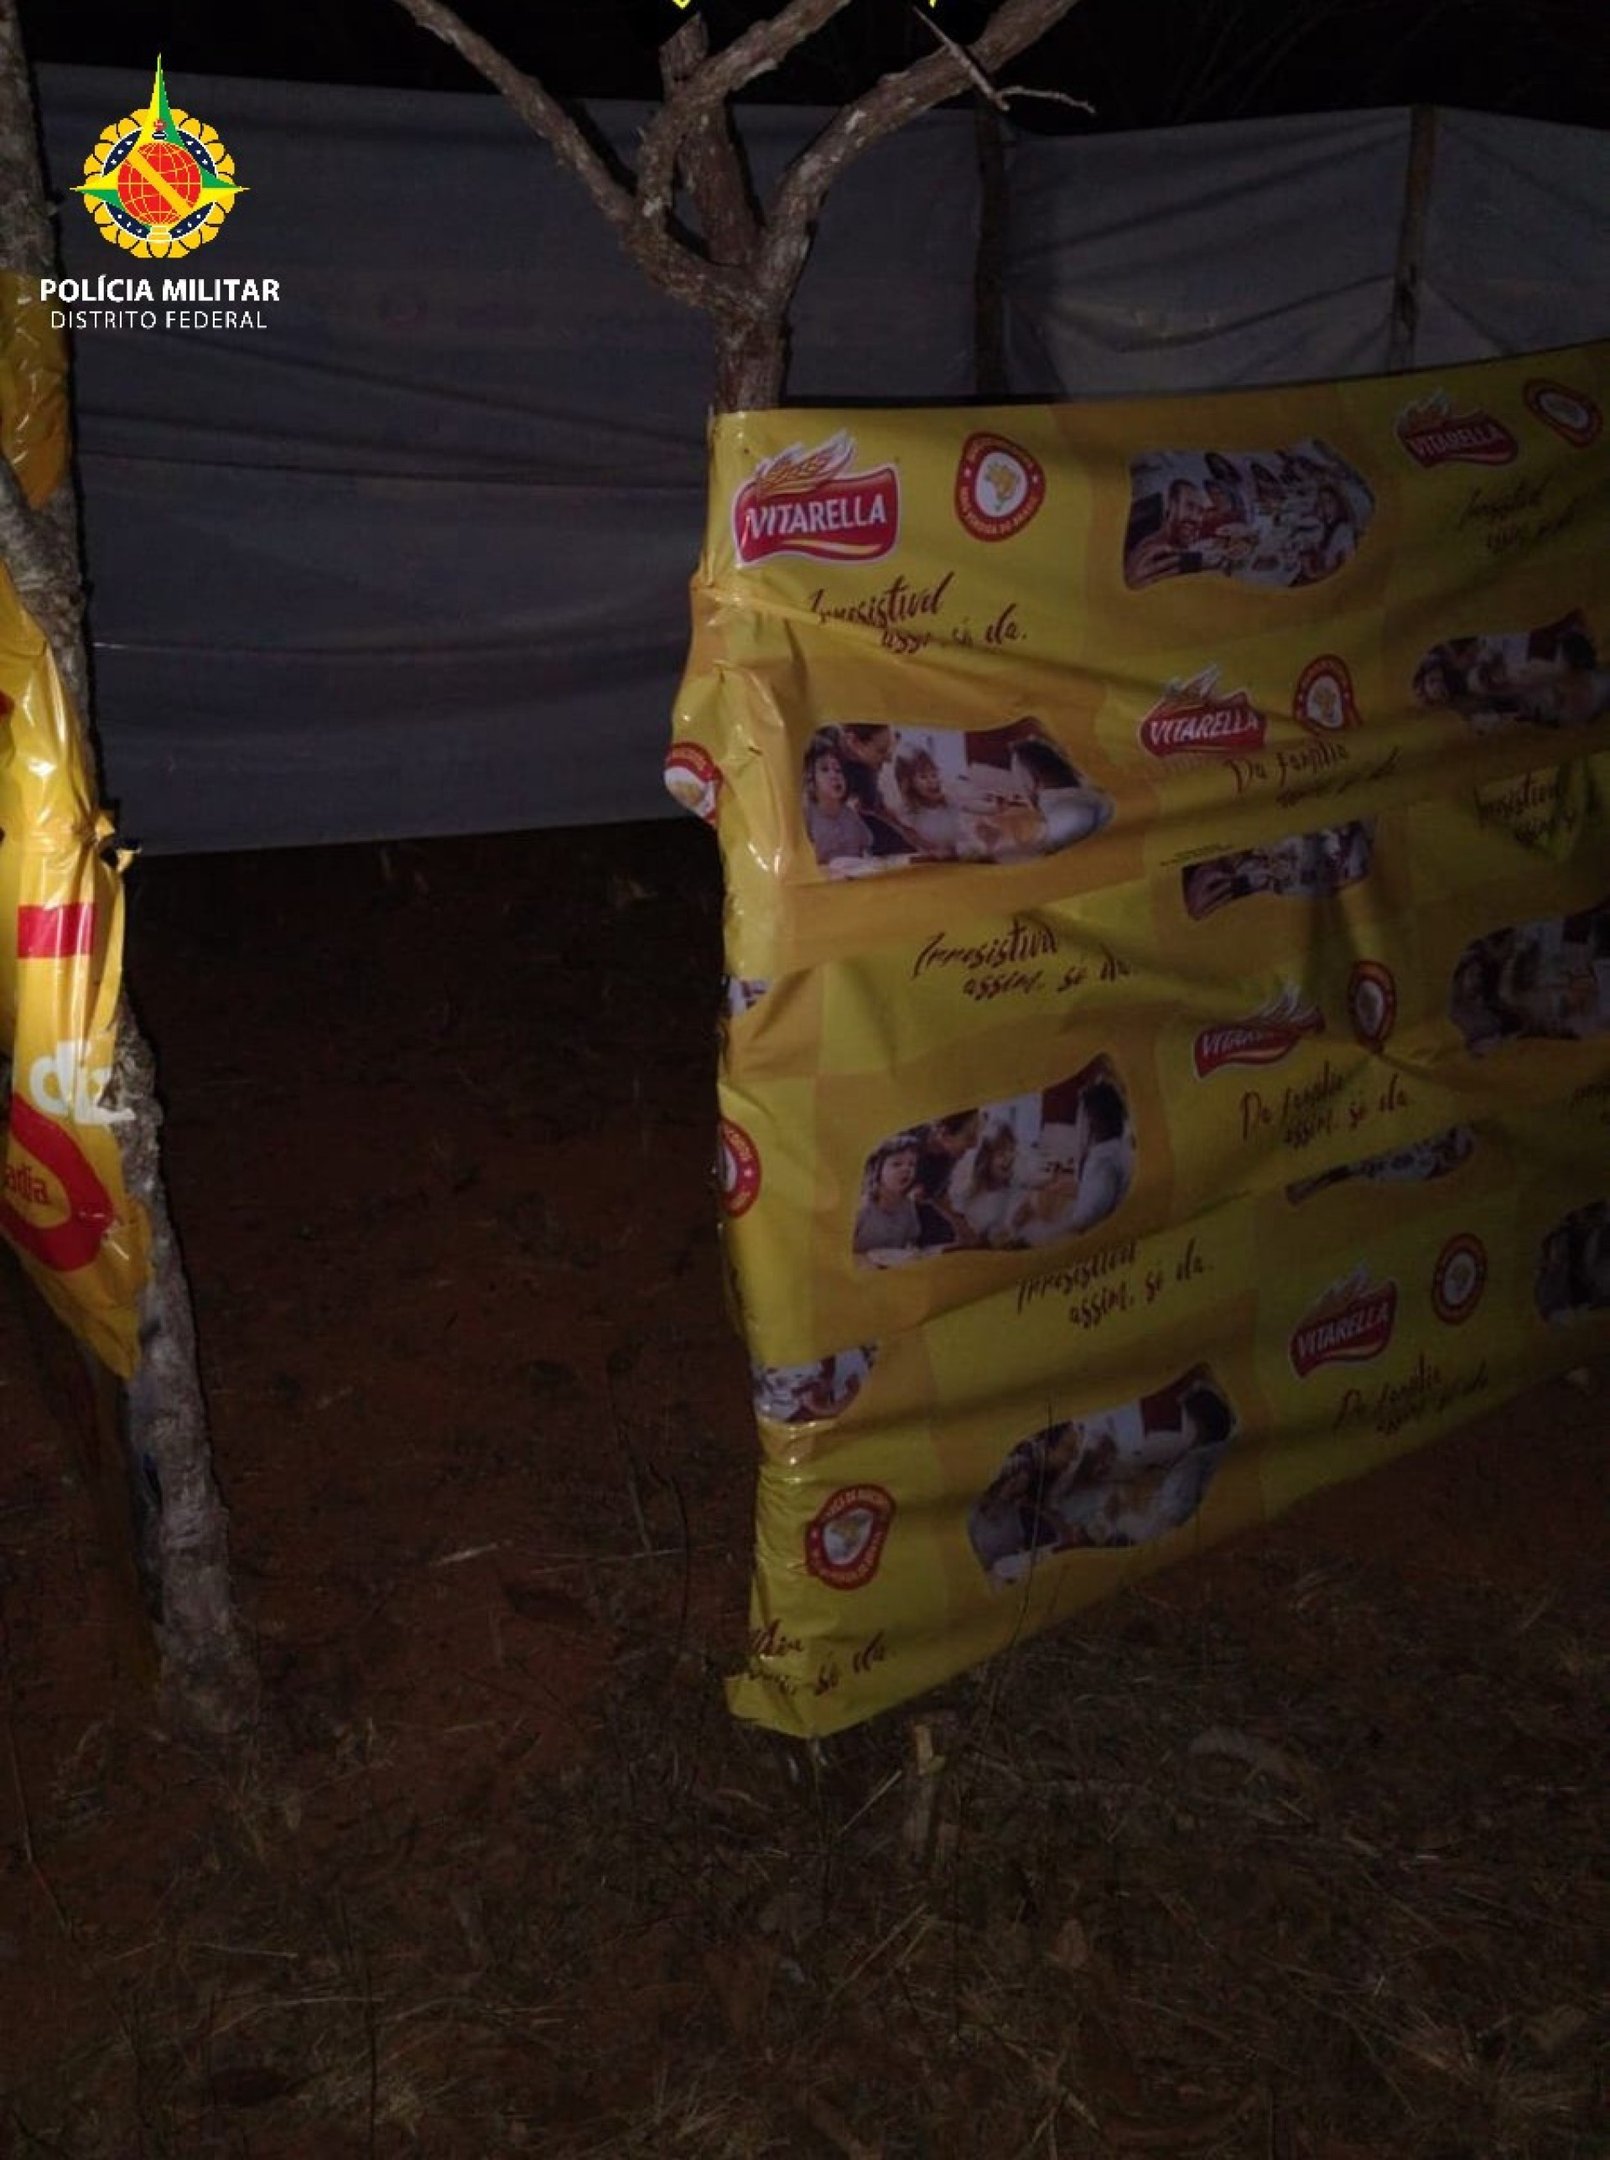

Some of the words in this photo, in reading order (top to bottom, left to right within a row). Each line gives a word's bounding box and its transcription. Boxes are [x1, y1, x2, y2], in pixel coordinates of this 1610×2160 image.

[745, 493, 888, 541] VITARELLA
[1149, 703, 1261, 746] VITARELLA
[1297, 1301, 1390, 1358] VITARELLA
